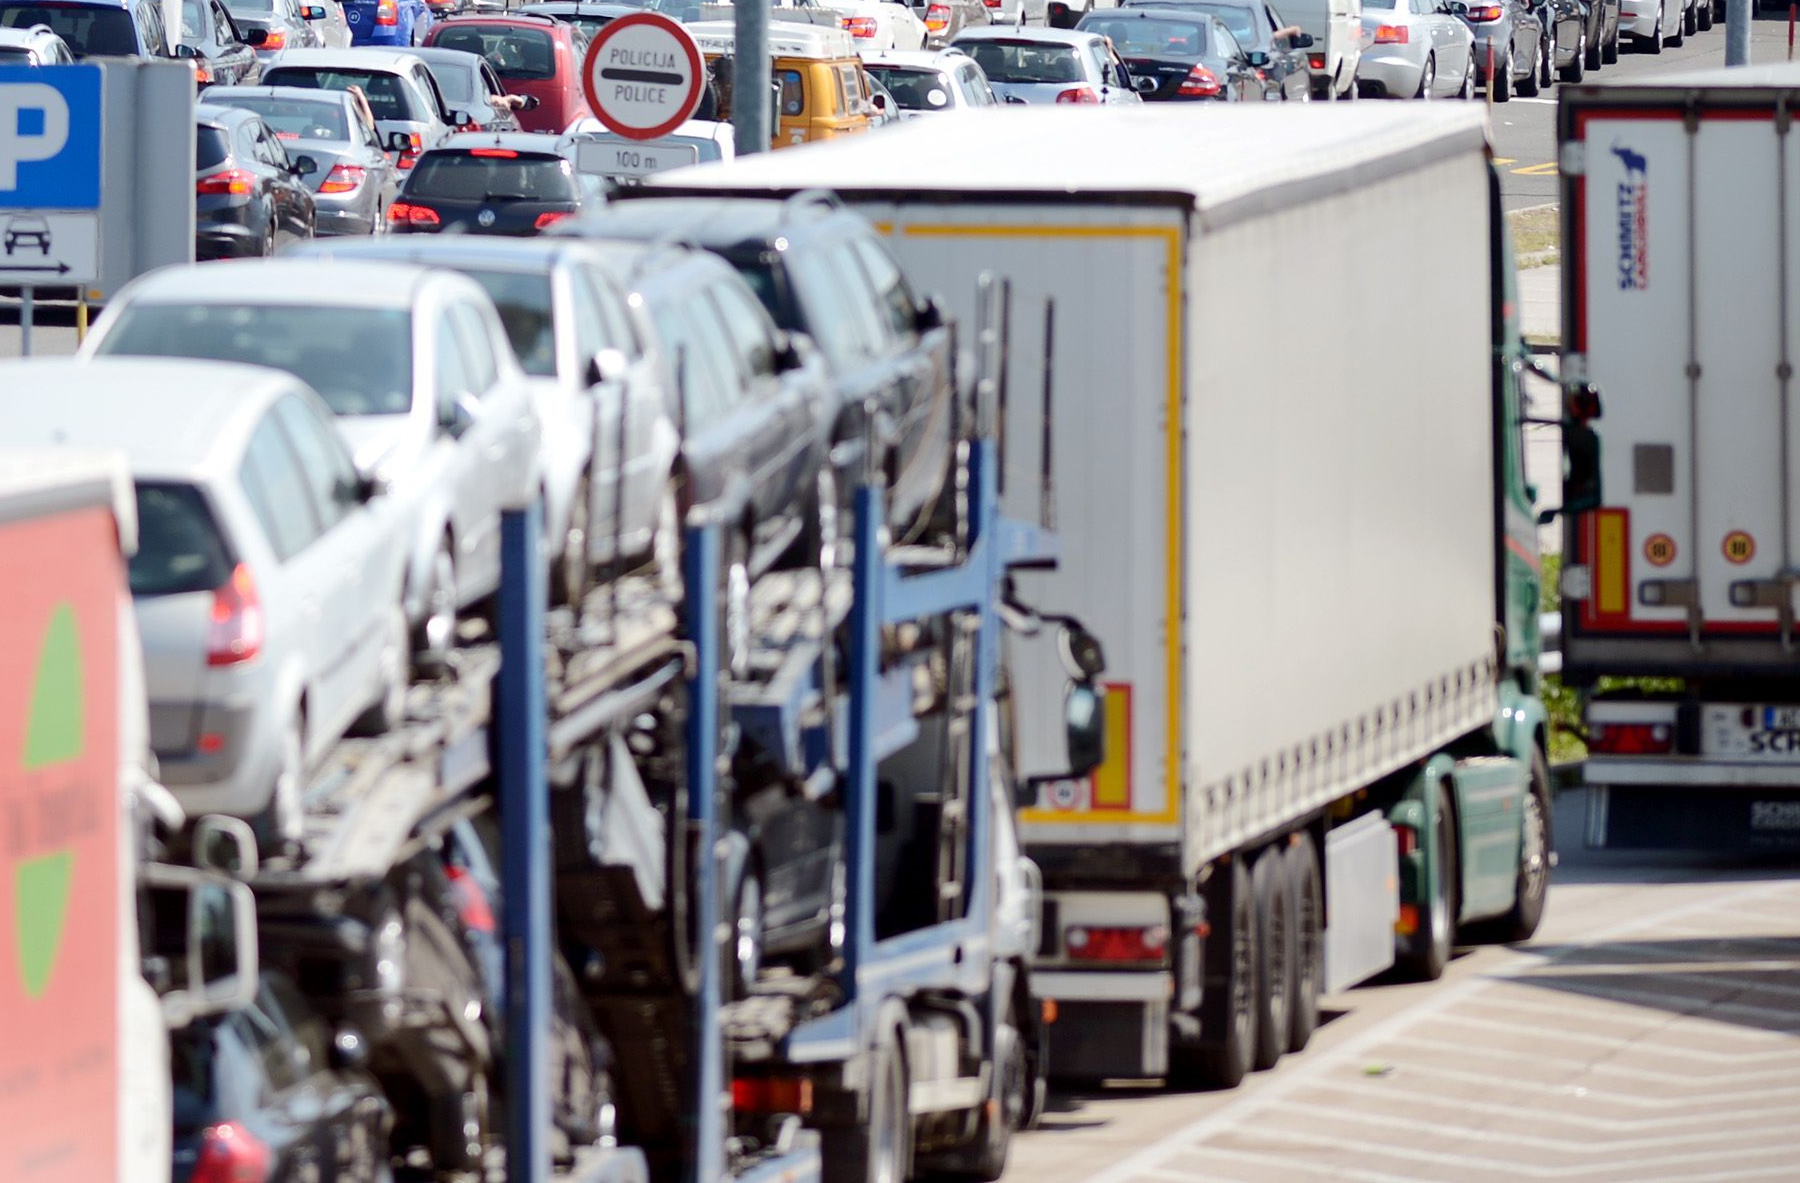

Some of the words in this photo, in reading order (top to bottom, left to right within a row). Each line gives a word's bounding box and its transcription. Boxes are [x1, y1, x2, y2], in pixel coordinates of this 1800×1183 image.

[610, 48, 676, 69] POLICIJA
[615, 84, 667, 104] POLICE
[616, 151, 640, 168] 100
[644, 157, 657, 169] m
[1618, 183, 1636, 290] SCHMITZ
